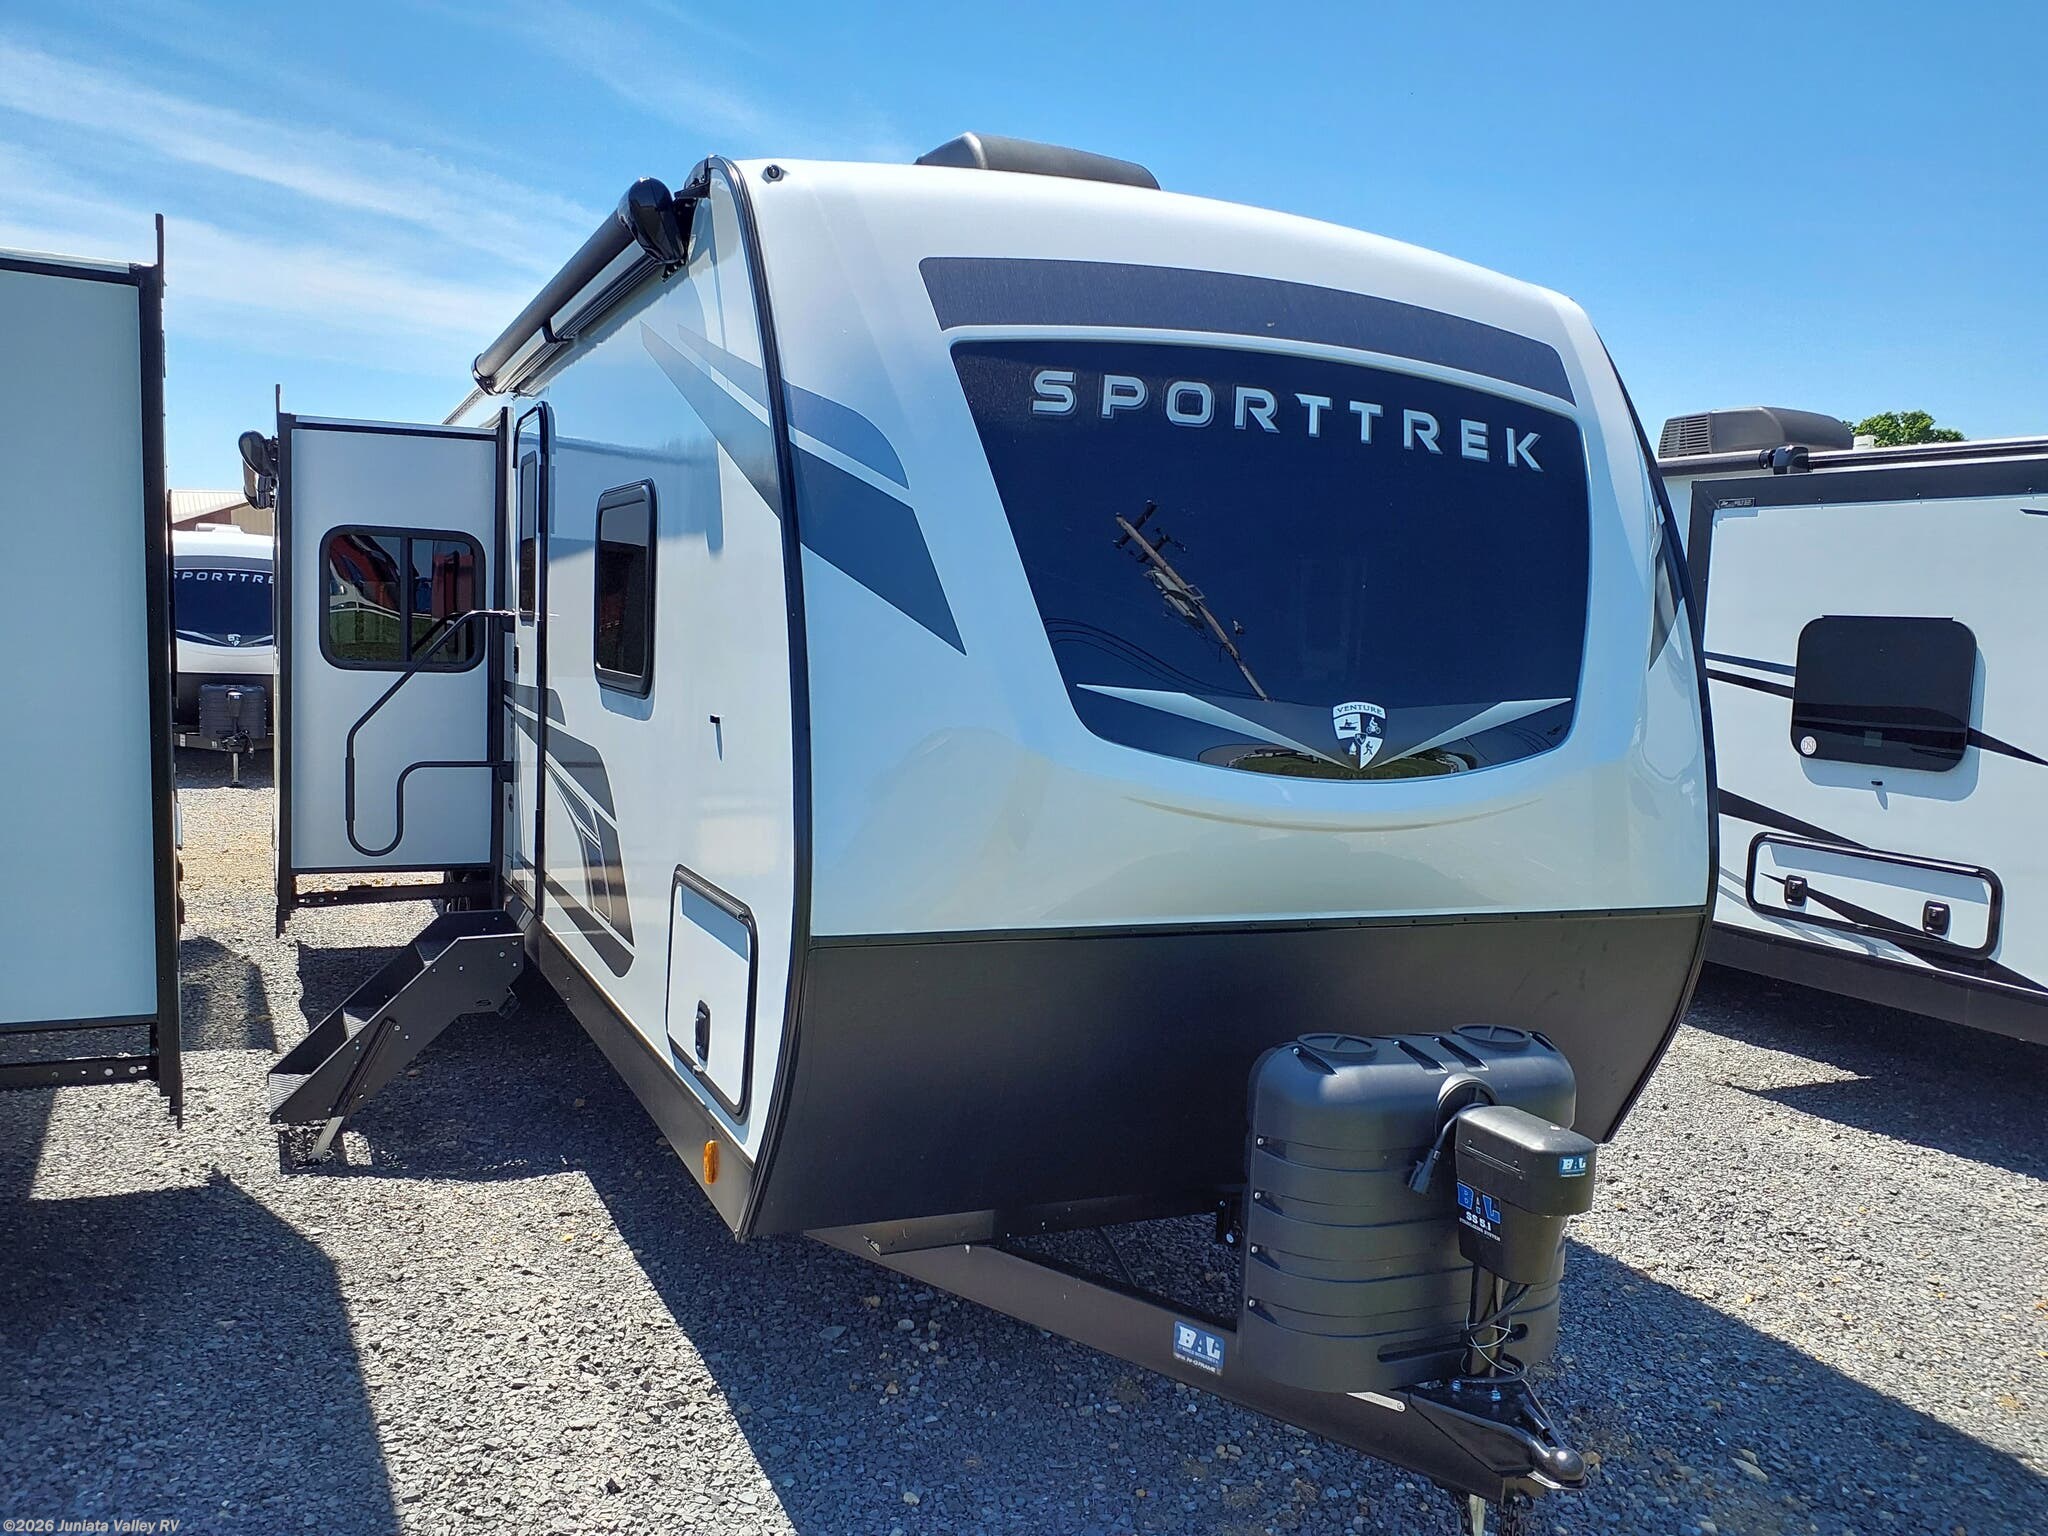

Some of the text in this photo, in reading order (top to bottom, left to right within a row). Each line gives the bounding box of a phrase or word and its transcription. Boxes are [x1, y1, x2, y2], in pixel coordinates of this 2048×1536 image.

[1032, 369, 1543, 472] SPORTTREK
[173, 571, 274, 584] PORTTRE
[1336, 704, 1382, 715] VENTURE
